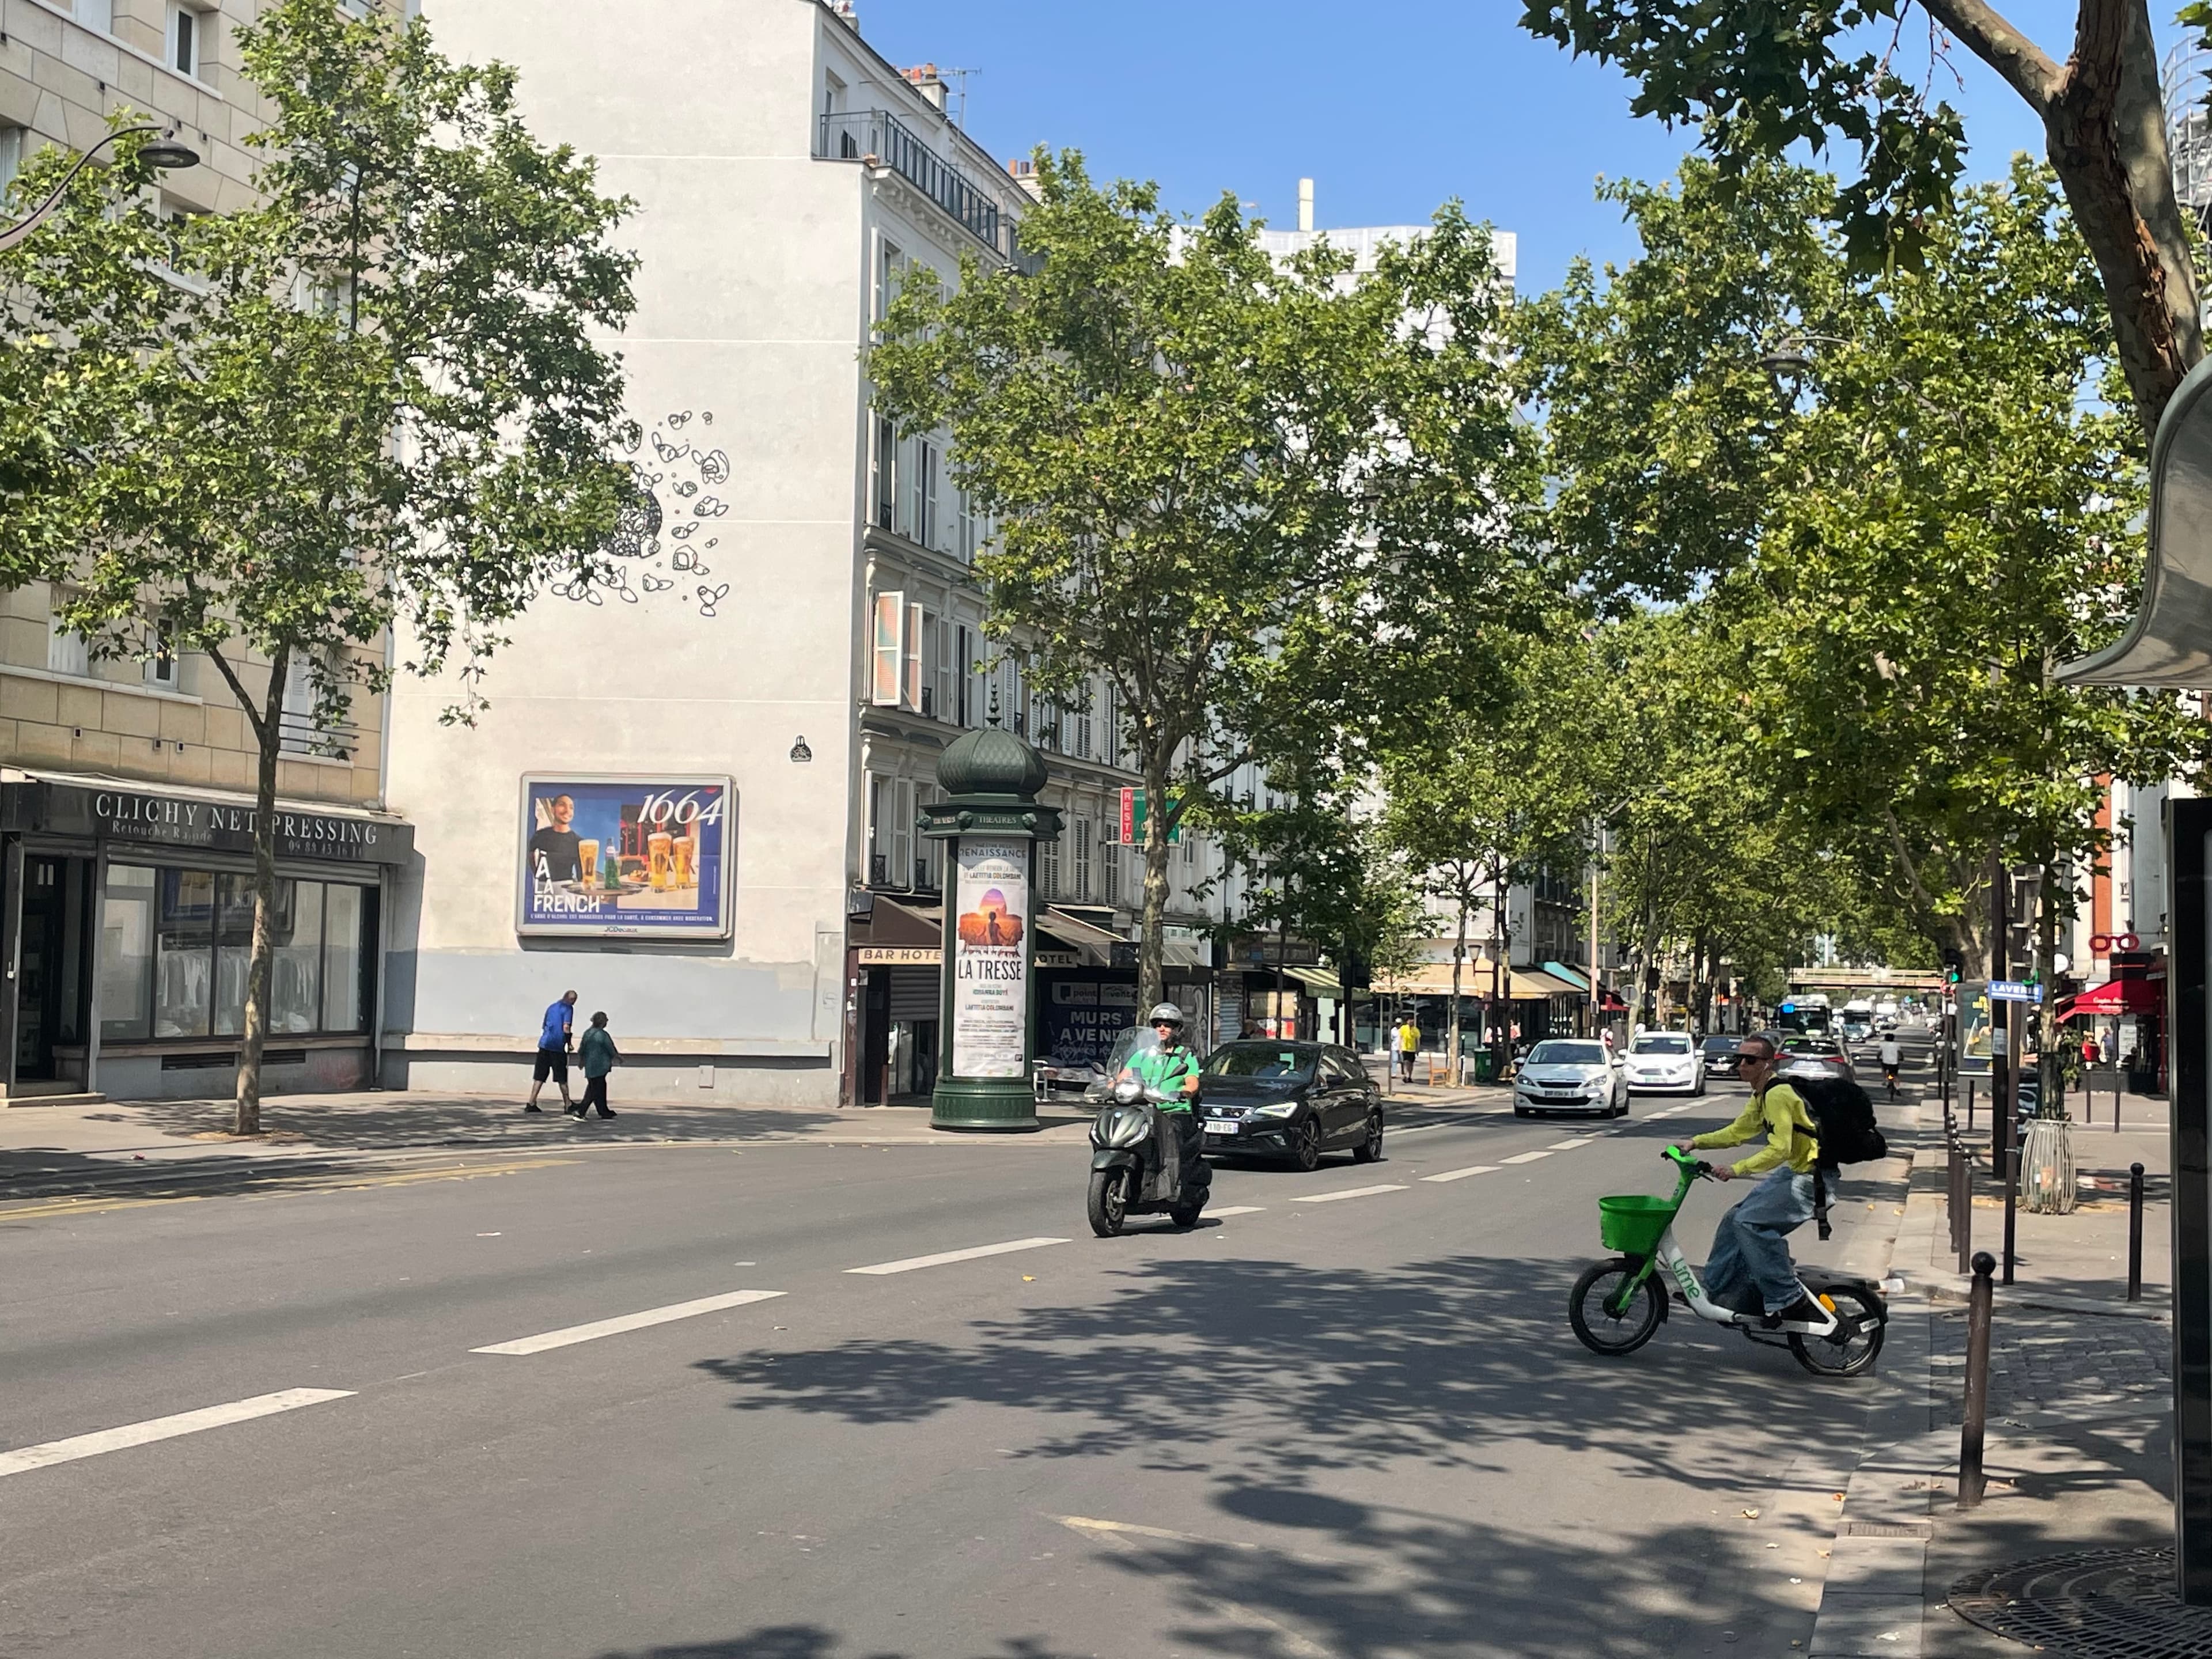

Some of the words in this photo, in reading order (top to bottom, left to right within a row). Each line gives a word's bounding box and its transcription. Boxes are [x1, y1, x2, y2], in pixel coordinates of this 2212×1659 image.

[637, 789, 724, 825] 1664
[96, 793, 198, 827] CLICHY
[210, 806, 257, 833] NET
[271, 814, 377, 844] PRESSING
[1123, 791, 1132, 842] RESTO
[112, 820, 167, 836] Retouche
[959, 848, 1027, 859] RENAISSANCE
[535, 878, 554, 895] LA
[864, 950, 895, 959] BAR
[901, 950, 941, 960] HOTE
[1039, 955, 1072, 964] OTEL
[959, 960, 973, 979] LA
[977, 960, 1022, 980] TRESSE
[1073, 990, 1097, 998] point
[1991, 983, 2040, 996] LAVERIE
[1070, 1011, 1122, 1025] MURS
[1060, 1028, 1072, 1041] A
[1074, 1028, 1135, 1042] VENDR
[1673, 1257, 1700, 1299] Lime
